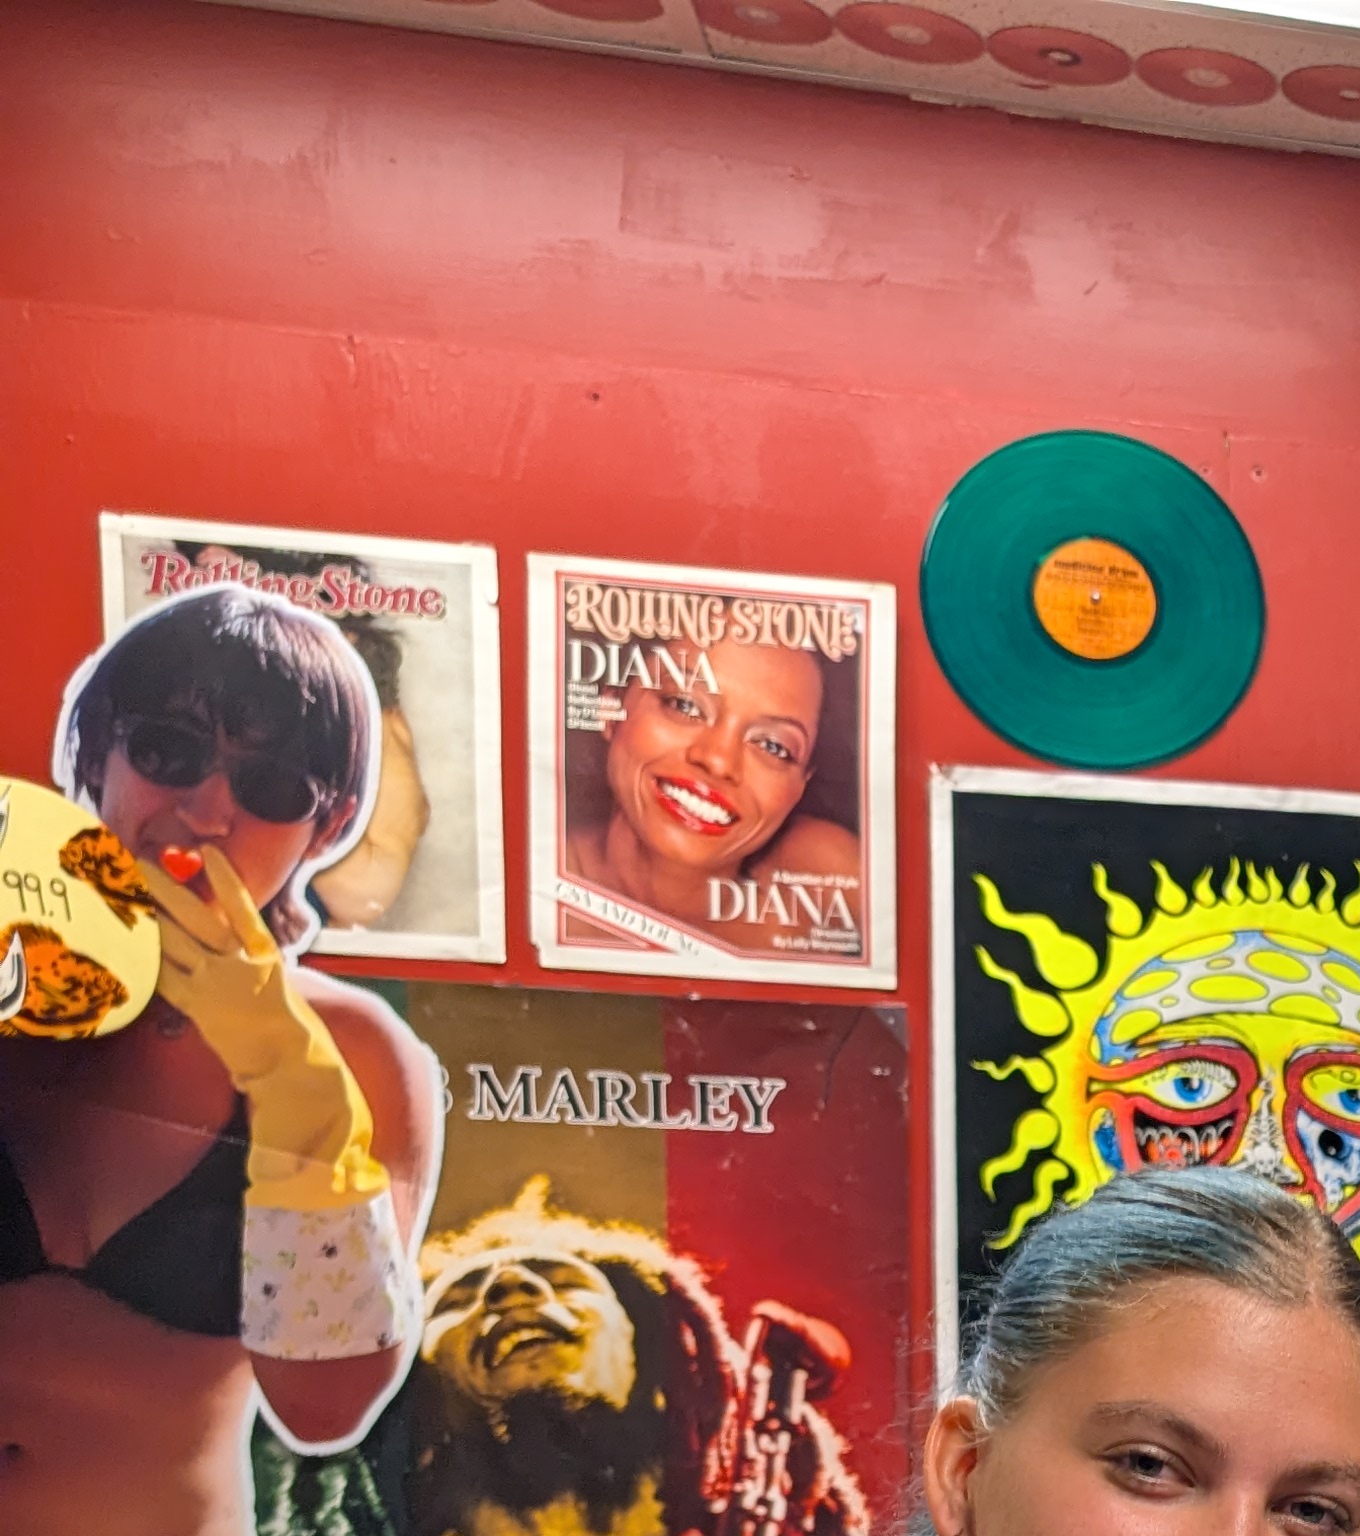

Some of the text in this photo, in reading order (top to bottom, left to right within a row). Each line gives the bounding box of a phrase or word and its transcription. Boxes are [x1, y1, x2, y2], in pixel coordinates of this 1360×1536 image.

[313, 564, 446, 617] Stone
[566, 582, 857, 662] ROLLING STONE
[568, 637, 721, 694] DIANA
[3, 869, 72, 922] 99.9
[707, 876, 857, 930] DIANA
[468, 1063, 787, 1134] MARLEY
